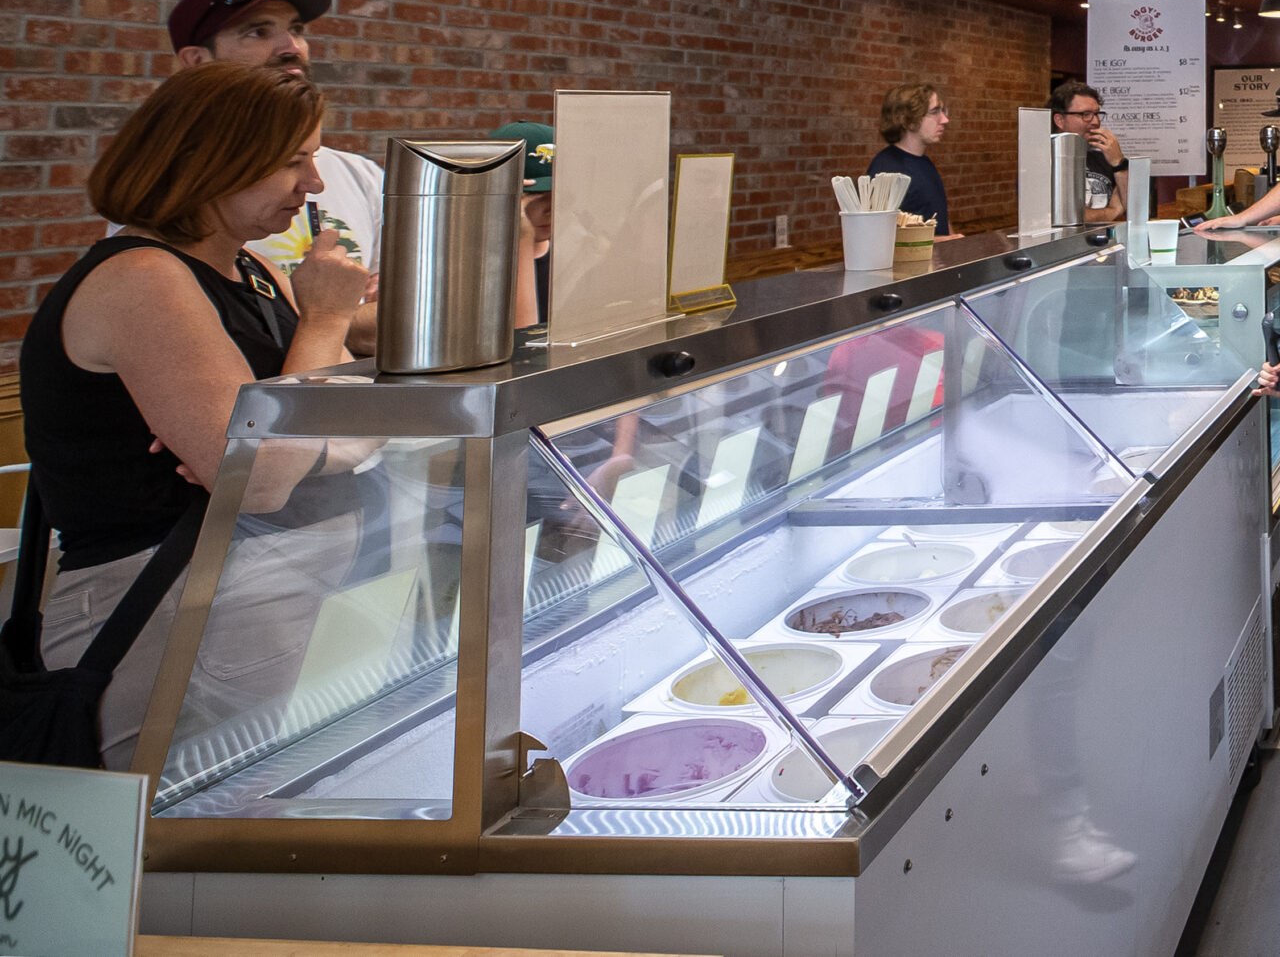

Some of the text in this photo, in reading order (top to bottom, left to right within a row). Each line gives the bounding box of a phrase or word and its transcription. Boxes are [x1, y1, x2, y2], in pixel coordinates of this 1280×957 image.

[1131, 7, 1161, 19] IGGY'S
[1129, 28, 1163, 42] BURGER
[1179, 58, 1187, 66] $8
[1112, 113, 1141, 121] CLASSIC
[1143, 112, 1160, 120] FRIES
[17, 799, 56, 834] MIC
[57, 823, 115, 891] NIGHT
